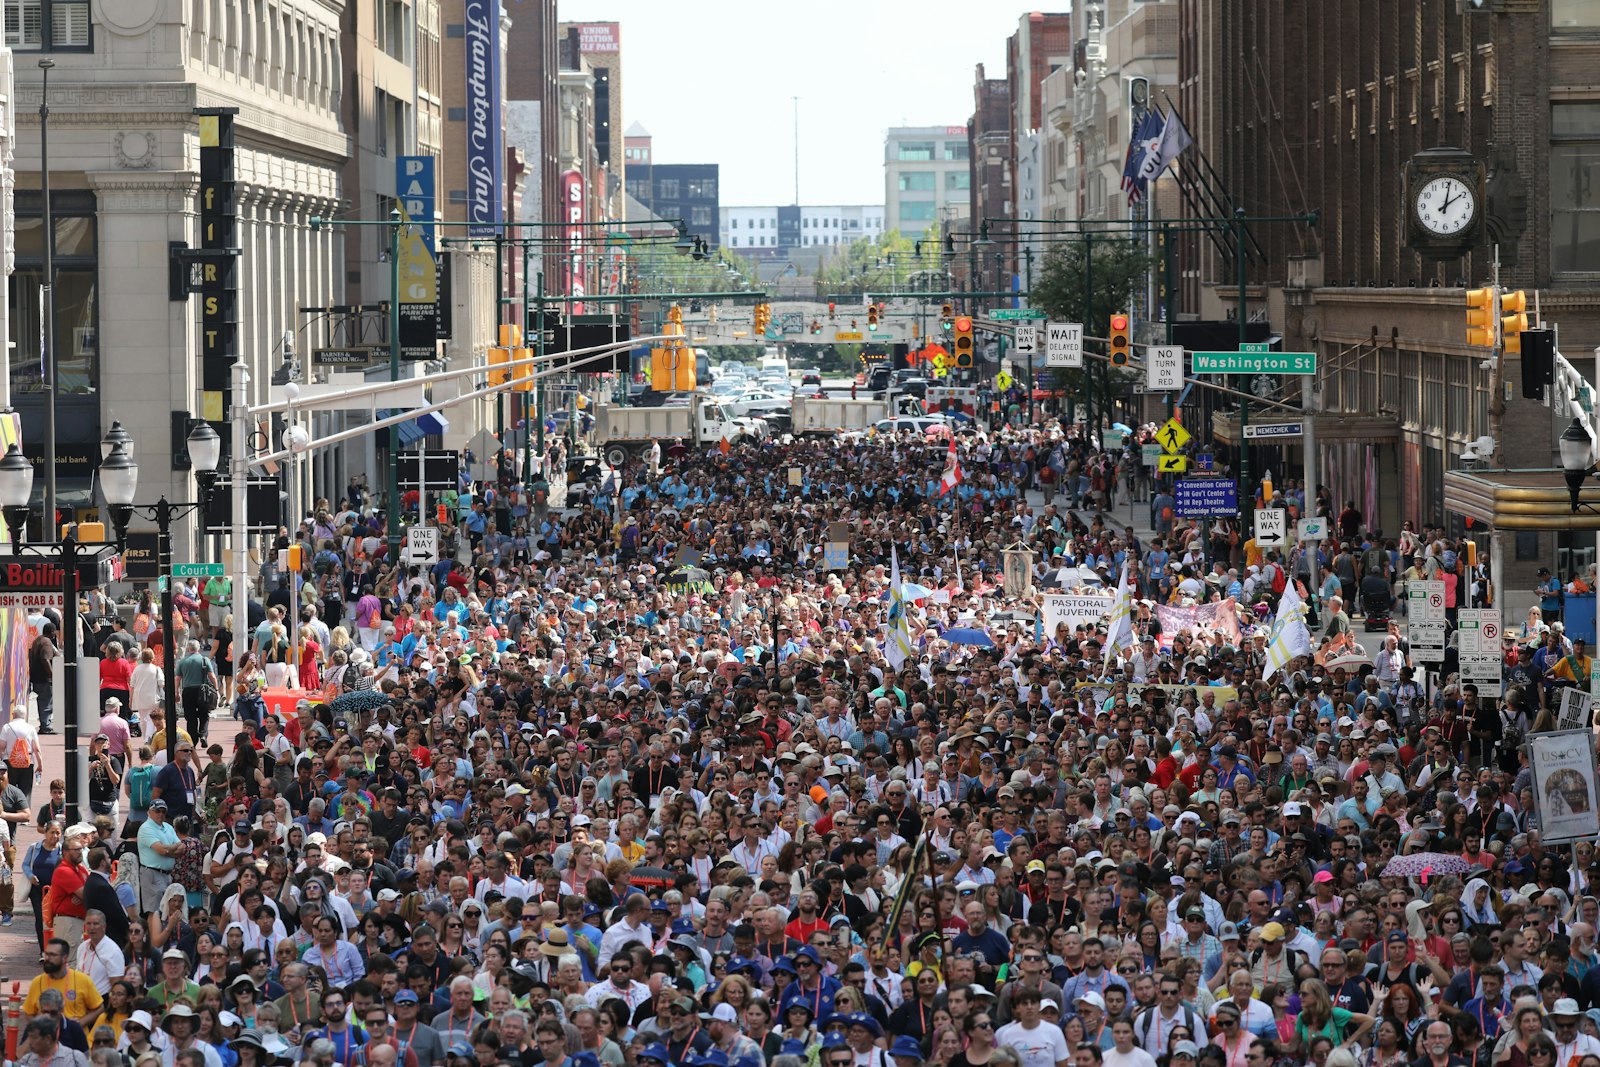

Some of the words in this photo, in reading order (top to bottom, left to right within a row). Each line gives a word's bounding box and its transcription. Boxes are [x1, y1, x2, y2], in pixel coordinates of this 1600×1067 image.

[466, 2, 490, 150] Hampton
[470, 156, 493, 224] Inn
[1051, 330, 1079, 339] WAIT
[1198, 357, 1288, 371] Washington
[1295, 358, 1310, 369] St
[1257, 427, 1288, 435] NEMECHEK
[1260, 512, 1279, 520] ONE
[1261, 522, 1280, 530] WAY
[413, 530, 432, 539] ONE
[180, 565, 209, 575] Court
[23, 596, 45, 605] CRAB
[49, 596, 54, 605] &
[1052, 600, 1107, 608] PASTORAL
[1568, 690, 1586, 708] DON'T
[1566, 705, 1582, 721] STOP
